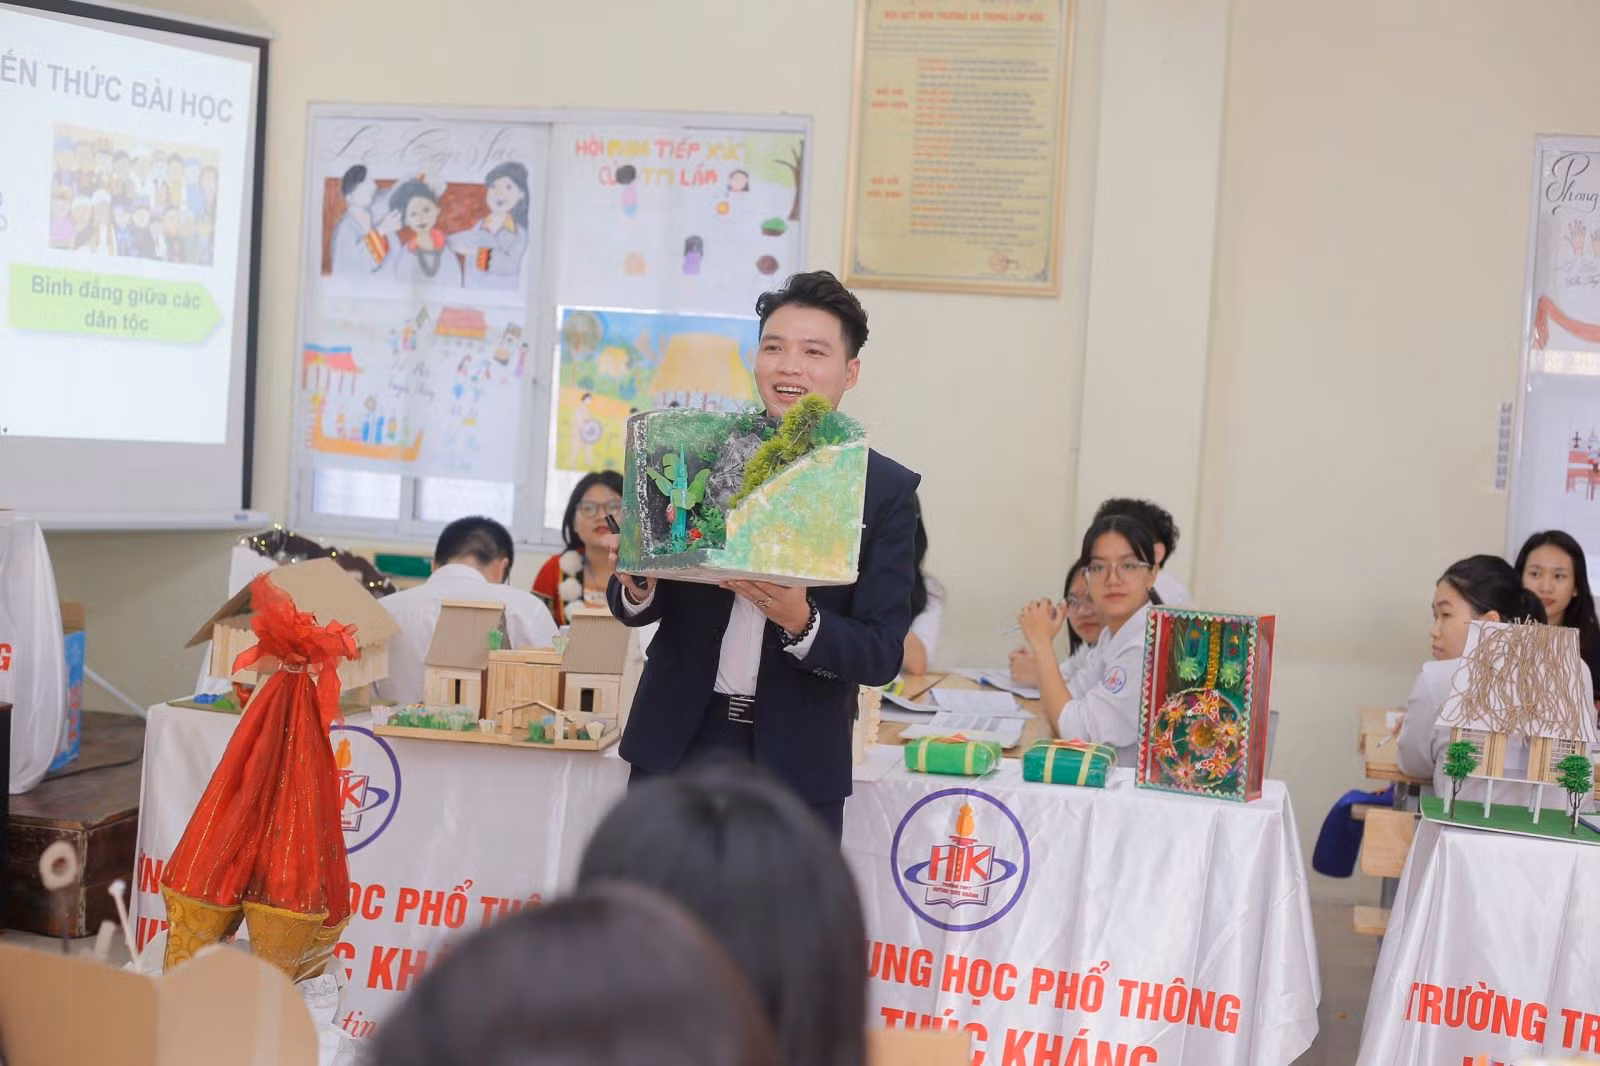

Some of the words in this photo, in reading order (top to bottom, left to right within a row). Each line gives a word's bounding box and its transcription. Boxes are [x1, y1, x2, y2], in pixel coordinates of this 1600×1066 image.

[47, 65, 122, 102] THỨC
[131, 78, 172, 113] BÀI
[180, 90, 233, 126] HỌC
[394, 880, 474, 929] PHỔ
[867, 941, 933, 988] UNG
[941, 953, 1017, 1007] HỌC
[1029, 960, 1111, 1014] PHỔ
[1118, 977, 1242, 1034] THÔNG
[1405, 981, 1548, 1044] TRƯỜNG
